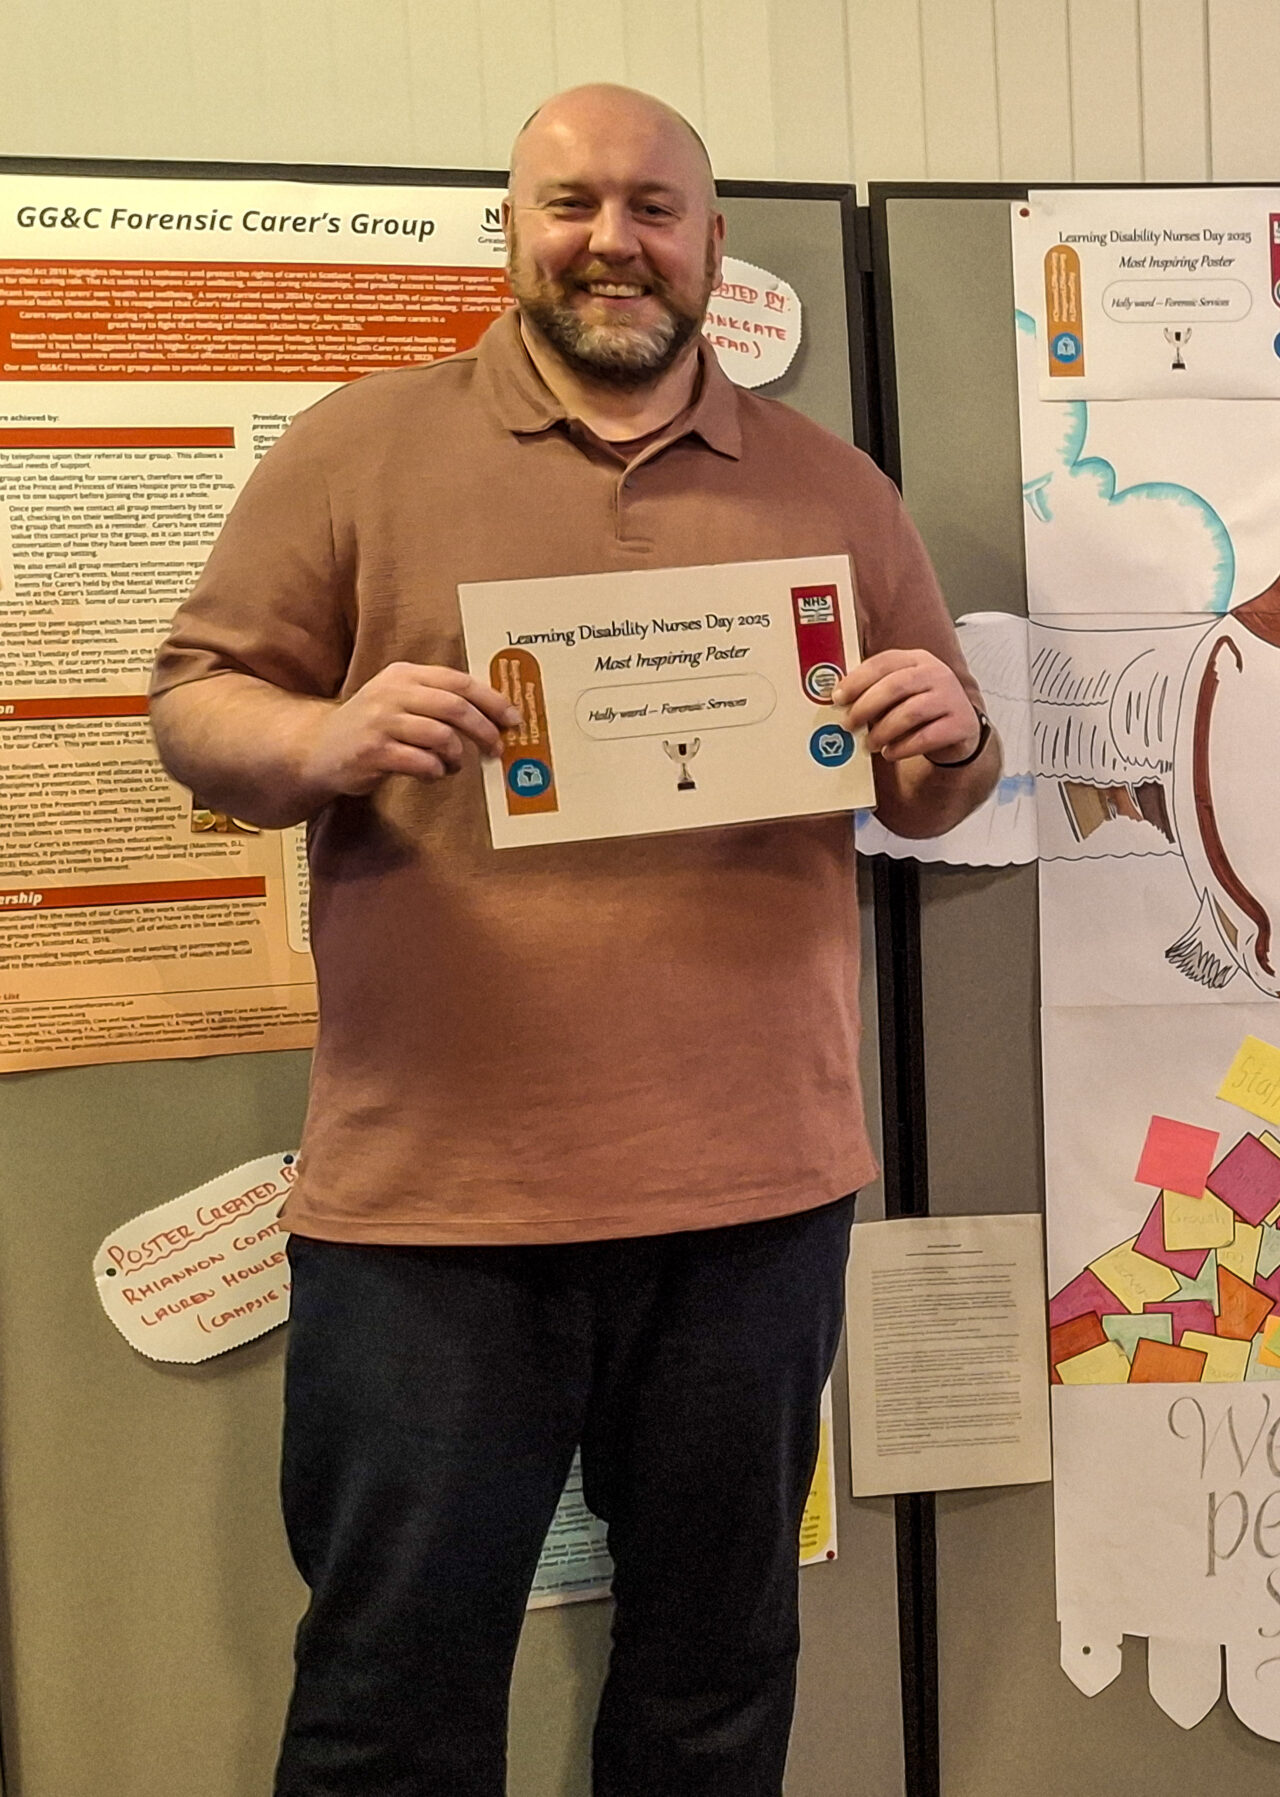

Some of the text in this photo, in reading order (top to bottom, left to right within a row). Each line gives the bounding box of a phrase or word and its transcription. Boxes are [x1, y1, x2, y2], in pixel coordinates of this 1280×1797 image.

[17, 206, 436, 243] GG&C Forensic Carer’s Group
[1059, 228, 1252, 247] Learning Disability Nurses Day 2025
[1119, 254, 1236, 272] Most Inspiring Poster
[506, 613, 771, 647] Learning Disability Nurses Day 2025
[594, 645, 750, 673] Most Inspiring Poster
[588, 707, 617, 723] Holly
[107, 1166, 298, 1270] POSTER CREATED B
[122, 1253, 225, 1305] RHIANNON
[141, 1251, 286, 1327] LAUREN HOWLE
[197, 1290, 280, 1333] (CAMPSIE
